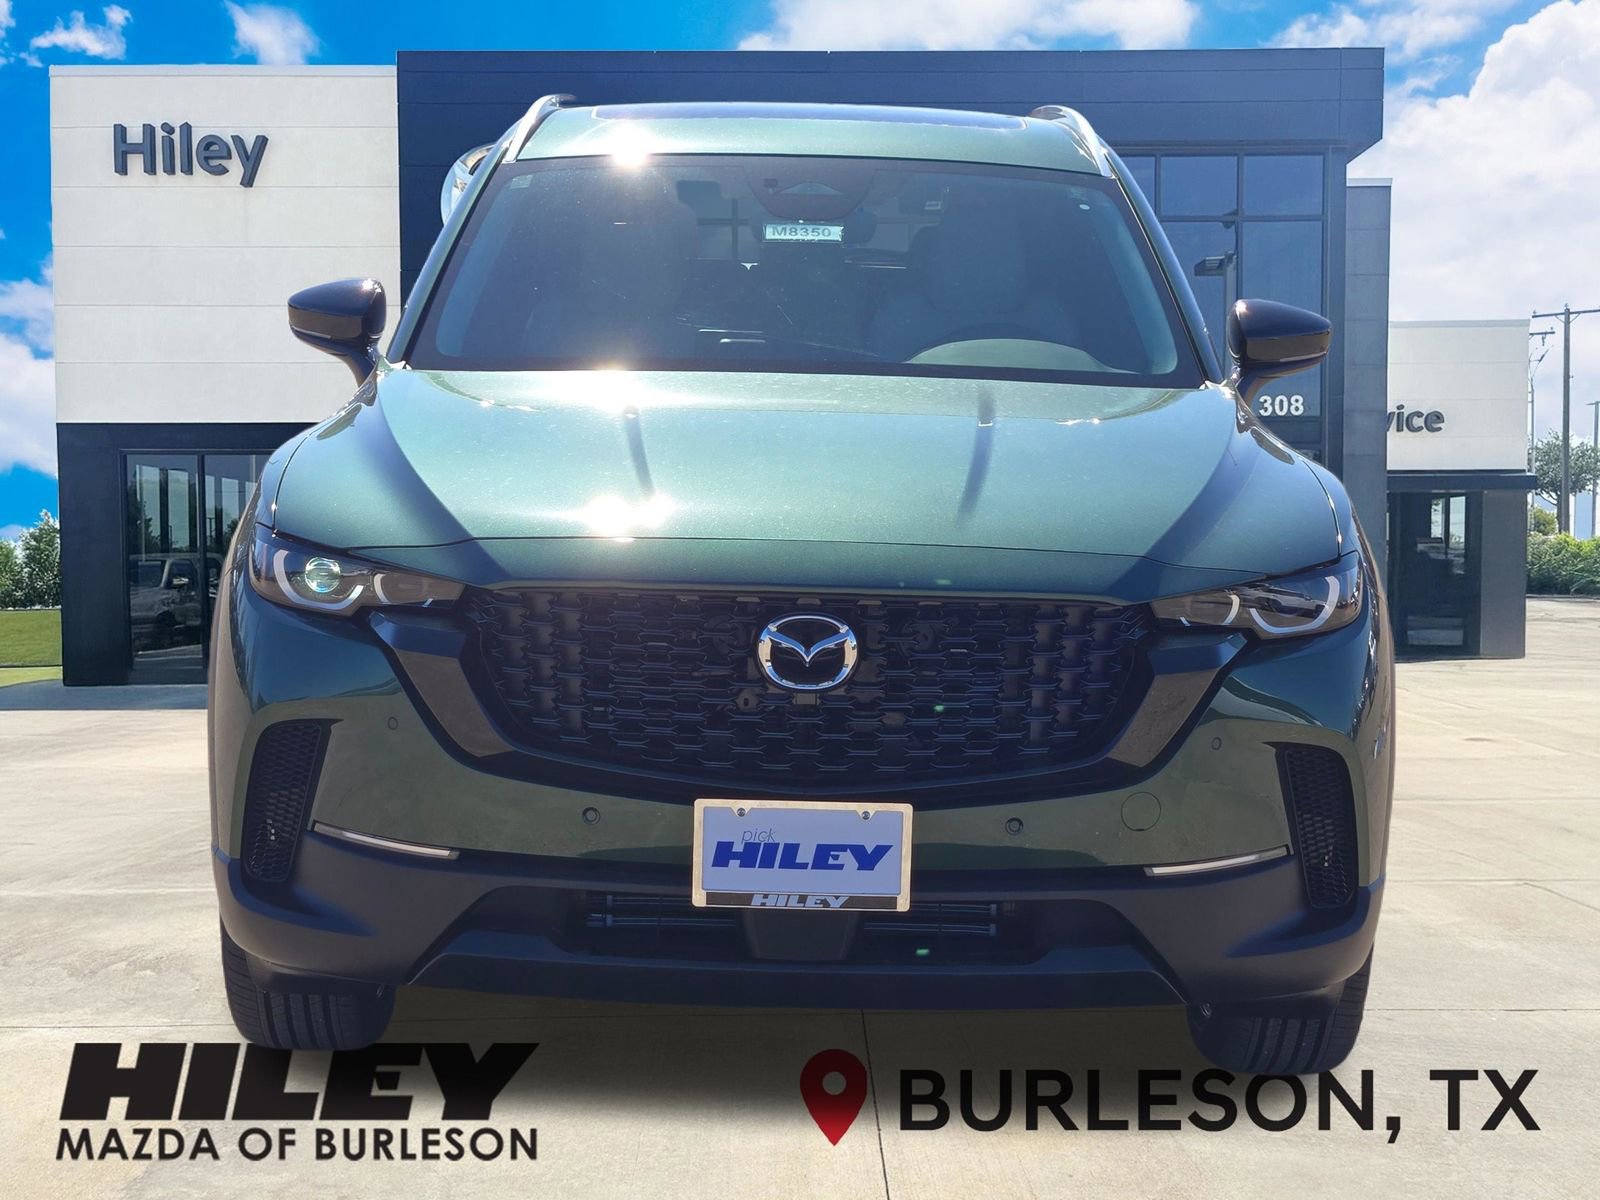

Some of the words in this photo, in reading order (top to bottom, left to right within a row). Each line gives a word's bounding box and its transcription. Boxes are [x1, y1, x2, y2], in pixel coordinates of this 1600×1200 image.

[113, 121, 269, 188] Hiley
[772, 226, 831, 237] M8350
[1258, 394, 1304, 416] 308
[741, 828, 776, 844] pick
[711, 841, 893, 871] HILEY
[751, 893, 849, 908] HILEY
